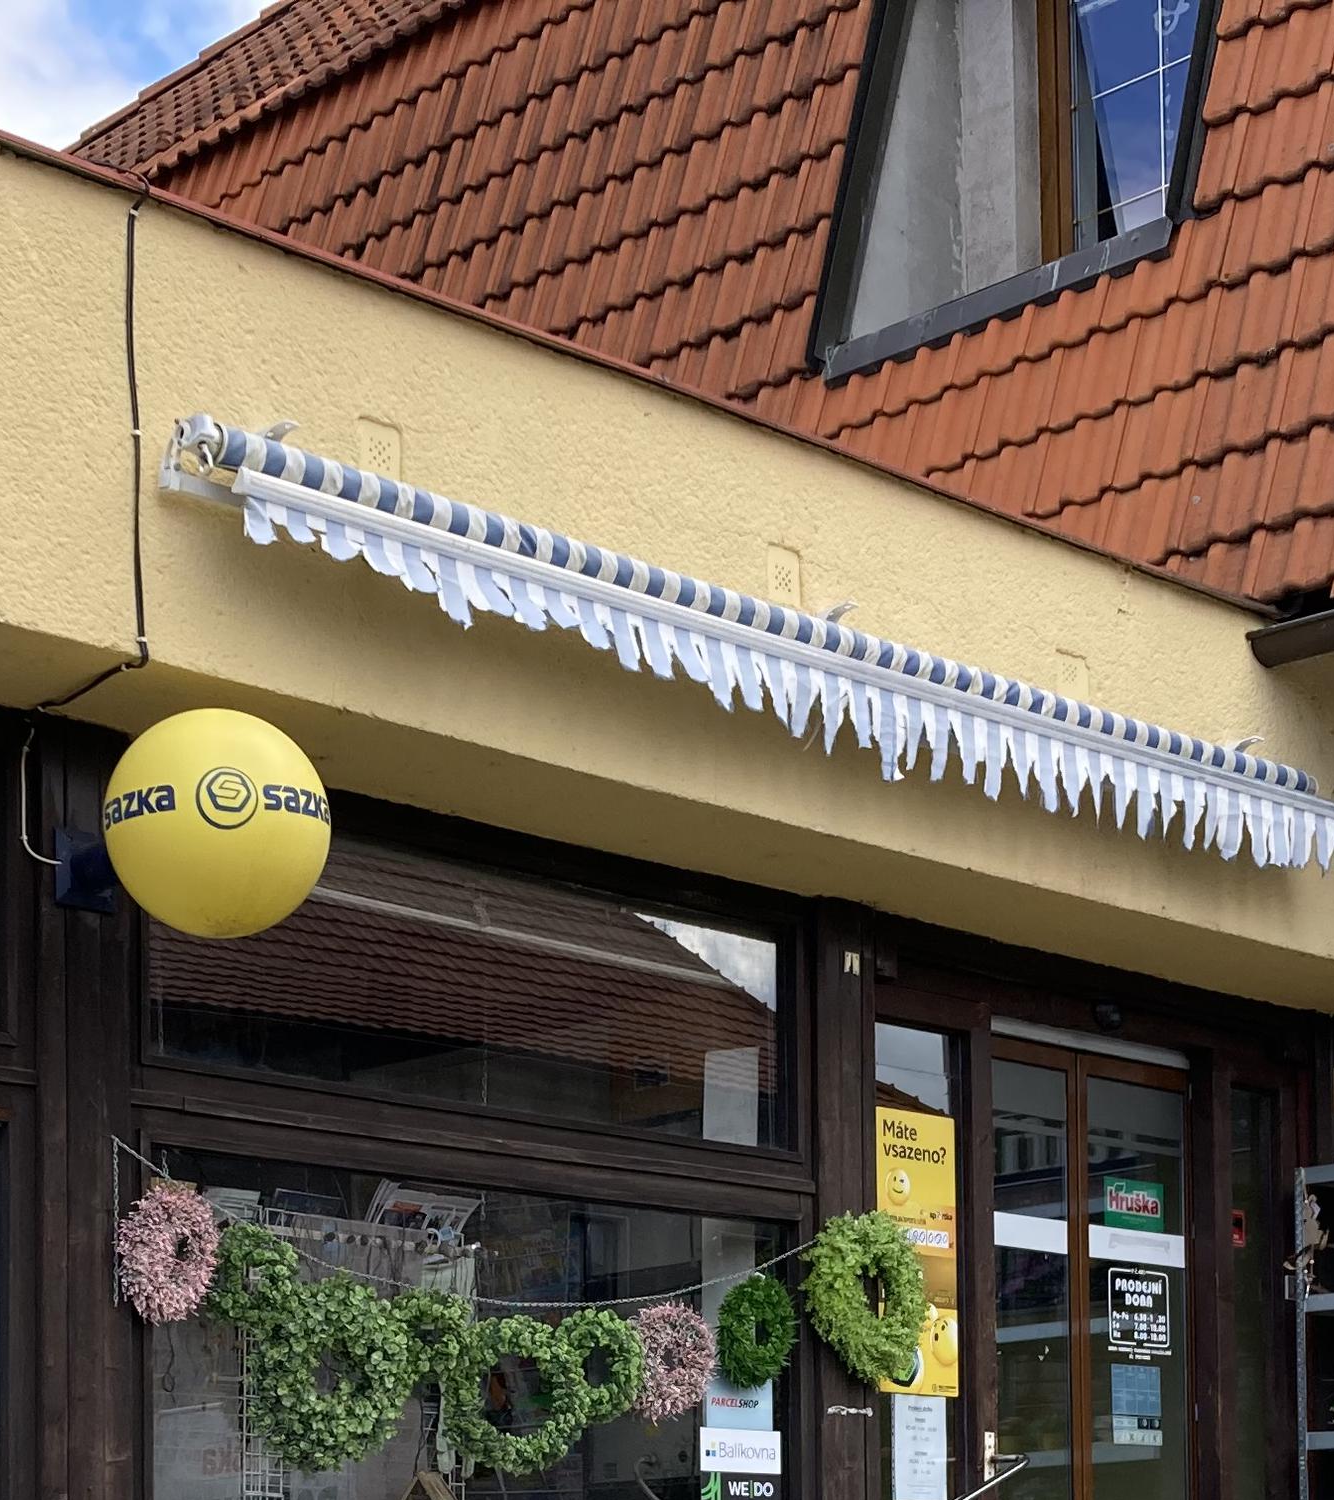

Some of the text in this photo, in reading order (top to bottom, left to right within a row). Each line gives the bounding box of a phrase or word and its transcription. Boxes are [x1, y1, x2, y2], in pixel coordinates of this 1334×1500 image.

[882, 1119, 918, 1141] Máte
[883, 1143, 947, 1165] vsazeno?
[1108, 1190, 1160, 1216] Hruška
[1114, 1277, 1163, 1295] PRODEJNÍ
[1124, 1292, 1153, 1309] DOBA
[710, 1396, 760, 1409] PARCELSHOP
[718, 1441, 777, 1461] Balíkovna
